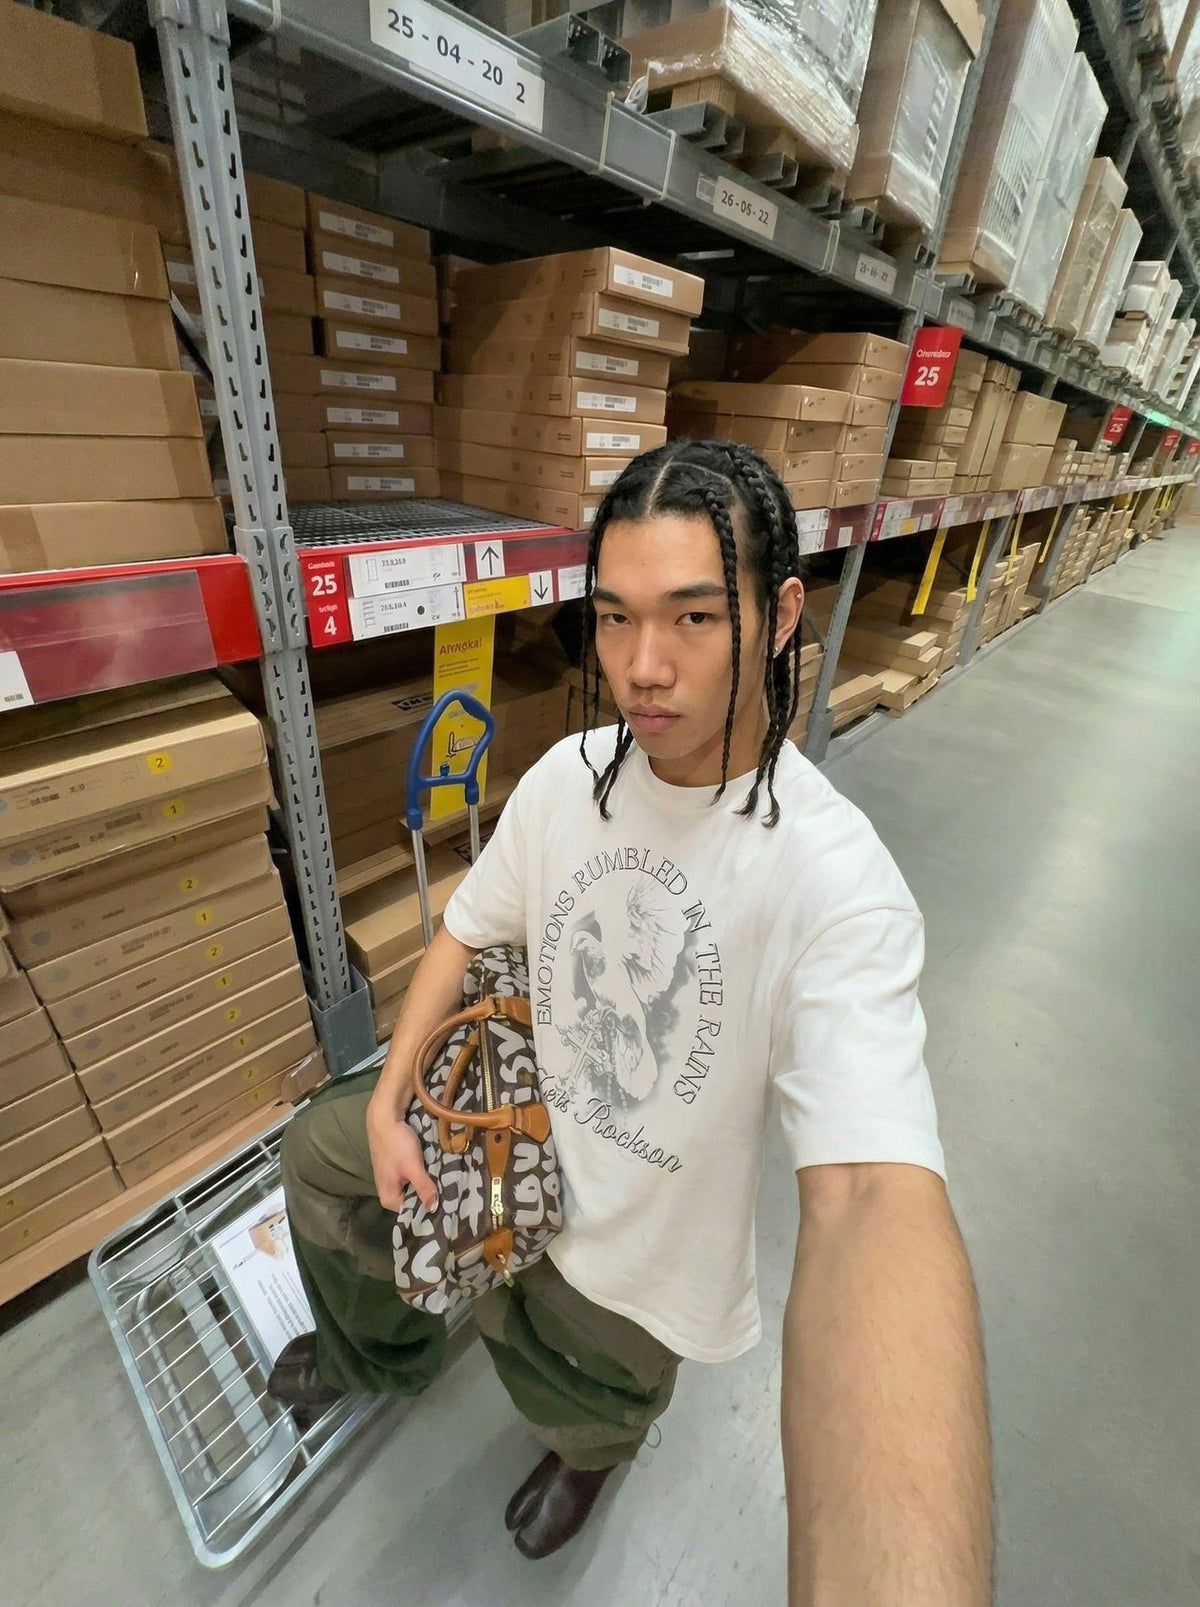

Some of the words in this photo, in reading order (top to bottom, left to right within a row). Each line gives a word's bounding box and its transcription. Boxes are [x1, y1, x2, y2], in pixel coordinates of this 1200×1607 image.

[387, 8, 414, 39] 25
[515, 82, 525, 104] 2
[914, 365, 941, 387] 25
[310, 573, 338, 597] 25
[324, 615, 338, 636] 4
[155, 757, 164, 768] 2
[170, 804, 177, 814] 1
[571, 847, 688, 896] RUMBLED
[186, 879, 193, 889] 2
[201, 913, 207, 921] 1
[681, 899, 712, 934] IN
[211, 947, 218, 957] 2
[536, 889, 576, 1026] EMOTIONS
[695, 943, 724, 1006] THE
[673, 1014, 722, 1105] RAINS
[574, 1097, 683, 1173] Rockson
